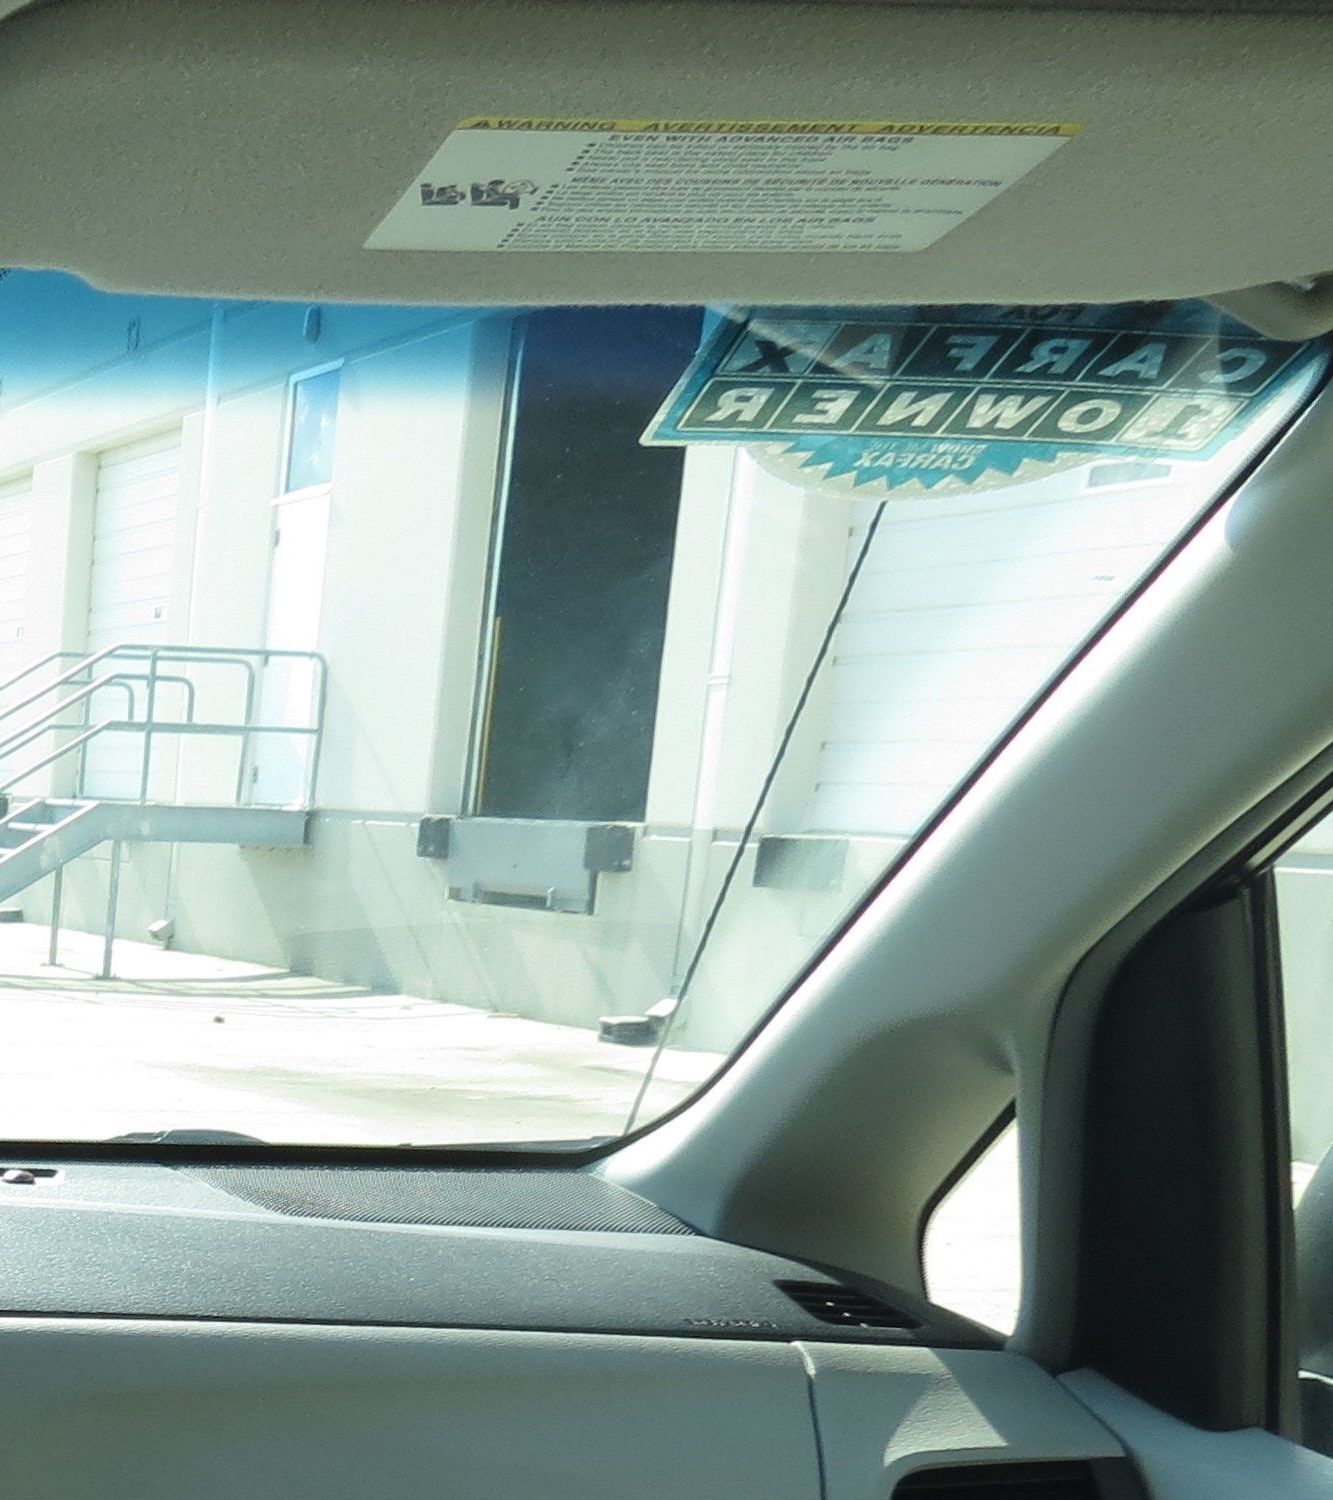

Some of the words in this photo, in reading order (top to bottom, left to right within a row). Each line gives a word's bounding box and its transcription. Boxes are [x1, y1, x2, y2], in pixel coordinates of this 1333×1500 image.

[496, 119, 617, 130] WARNING
[644, 122, 861, 134] AVERTISSEMENT
[881, 124, 1062, 136] ADVERTENCIA
[607, 134, 659, 142] EVEN
[665, 134, 710, 142] WITH
[715, 135, 819, 143] ADVANCED
